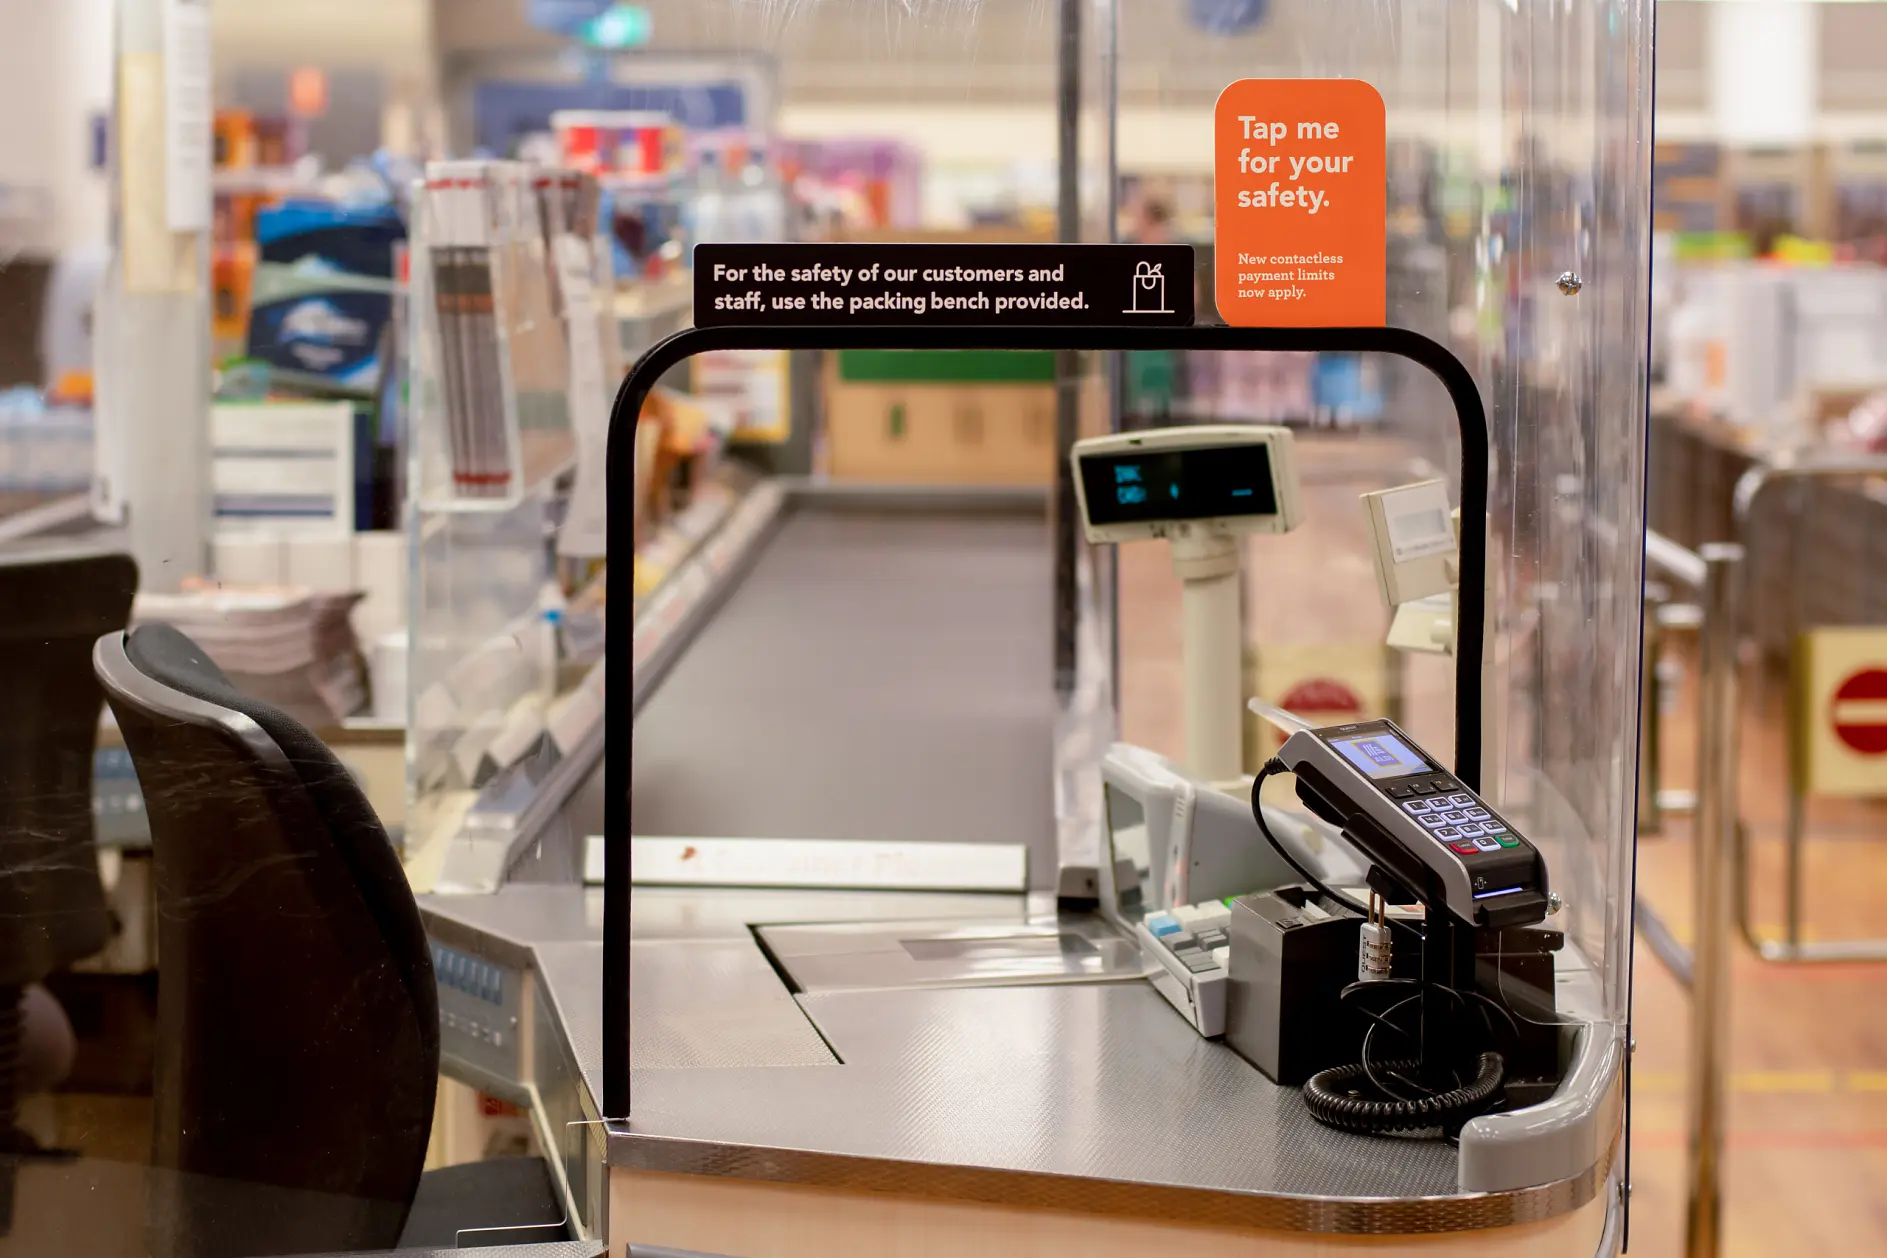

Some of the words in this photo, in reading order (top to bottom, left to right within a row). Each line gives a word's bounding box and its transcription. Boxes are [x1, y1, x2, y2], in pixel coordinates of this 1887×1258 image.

[1238, 116, 1288, 146] Tap
[1298, 122, 1340, 140] me
[1238, 148, 1281, 173] for
[1288, 155, 1354, 180] your
[1238, 181, 1330, 215] safety.
[1238, 253, 1267, 265] New
[1269, 251, 1344, 264] contactless
[713, 263, 748, 282] For
[752, 263, 786, 282] the
[791, 263, 854, 287] safety
[857, 263, 880, 282] of
[883, 268, 918, 282] our
[922, 266, 1024, 282] customers
[1028, 263, 1064, 282] and
[1238, 270, 1295, 284] payment
[1297, 268, 1335, 281] limits
[714, 291, 766, 313] staff,
[771, 296, 806, 311] use
[810, 291, 844, 310] the
[849, 291, 926, 315] packing
[930, 291, 990, 310] bench
[995, 291, 1090, 314] provided.
[1238, 289, 1265, 298] now
[1268, 284, 1307, 301] apply.
